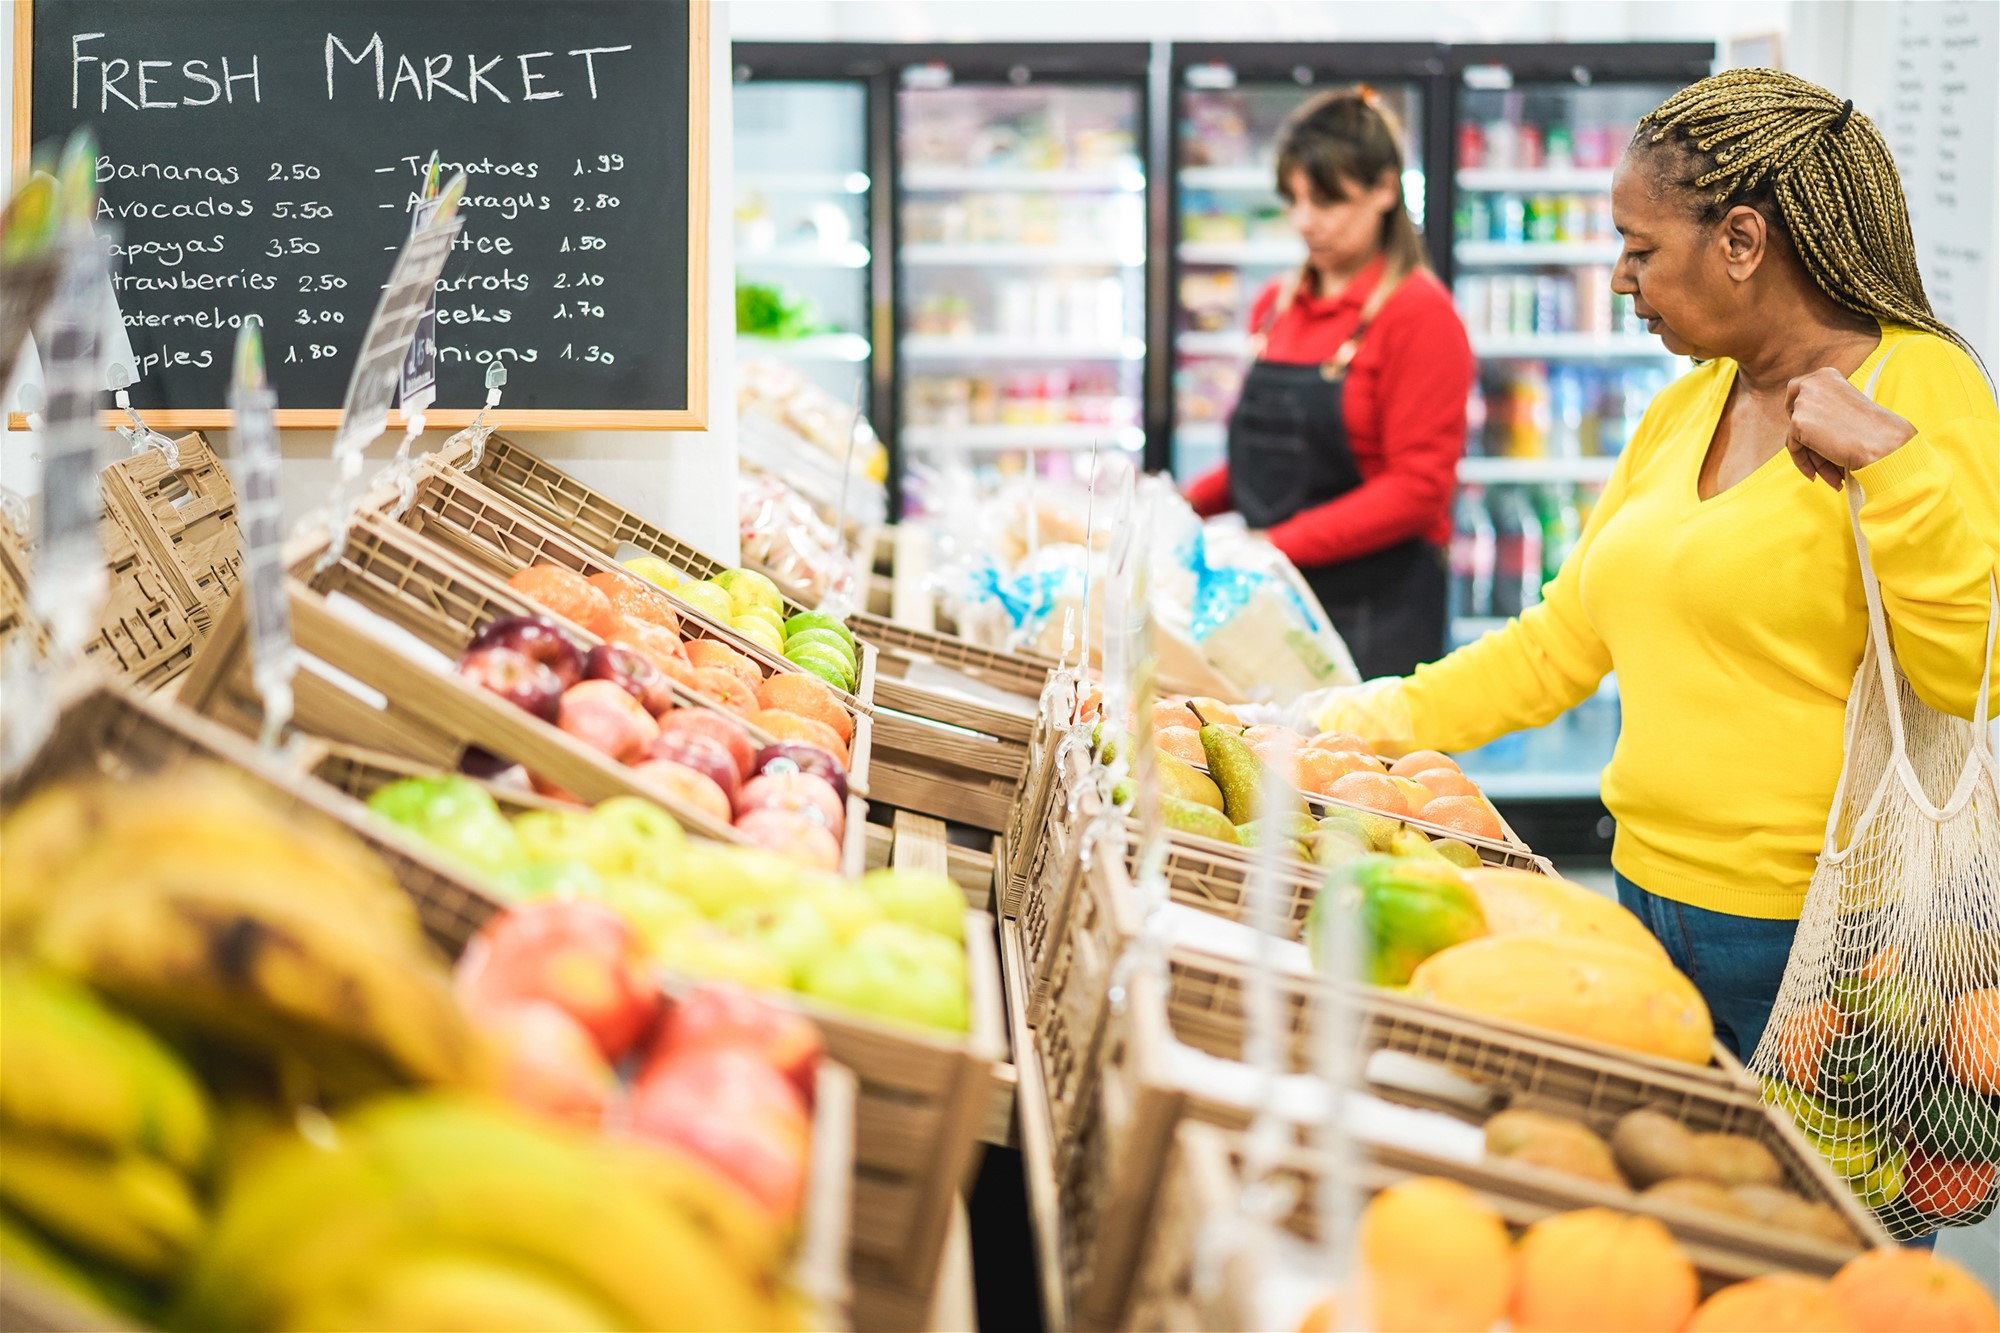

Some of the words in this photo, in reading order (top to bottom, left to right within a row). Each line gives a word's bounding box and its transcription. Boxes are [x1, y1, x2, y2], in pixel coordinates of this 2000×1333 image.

[72, 32, 260, 113] FRESH
[325, 32, 631, 103] MARKET
[95, 155, 239, 185] Bananas
[268, 163, 320, 181] 2.50
[401, 156, 538, 178] Tomatoes
[574, 154, 624, 176] 1.99
[95, 196, 253, 221] Avocados
[272, 202, 333, 219] 5.50
[406, 191, 550, 219] Aaragus
[573, 194, 620, 212] 2.80
[266, 238, 320, 257] 3.50
[560, 236, 606, 252] 1.50
[112, 269, 277, 291] trawberries
[299, 274, 347, 292] 2.50
[435, 269, 529, 292] arrots
[554, 273, 604, 288] 2.10
[121, 307, 264, 329] atermelon
[295, 309, 344, 324] 3.00
[436, 304, 512, 324] eeks
[553, 301, 604, 319] 1.70
[134, 344, 213, 376] ples
[285, 344, 337, 363] 1.80
[434, 344, 538, 364] nions
[561, 344, 614, 364] 1.30
